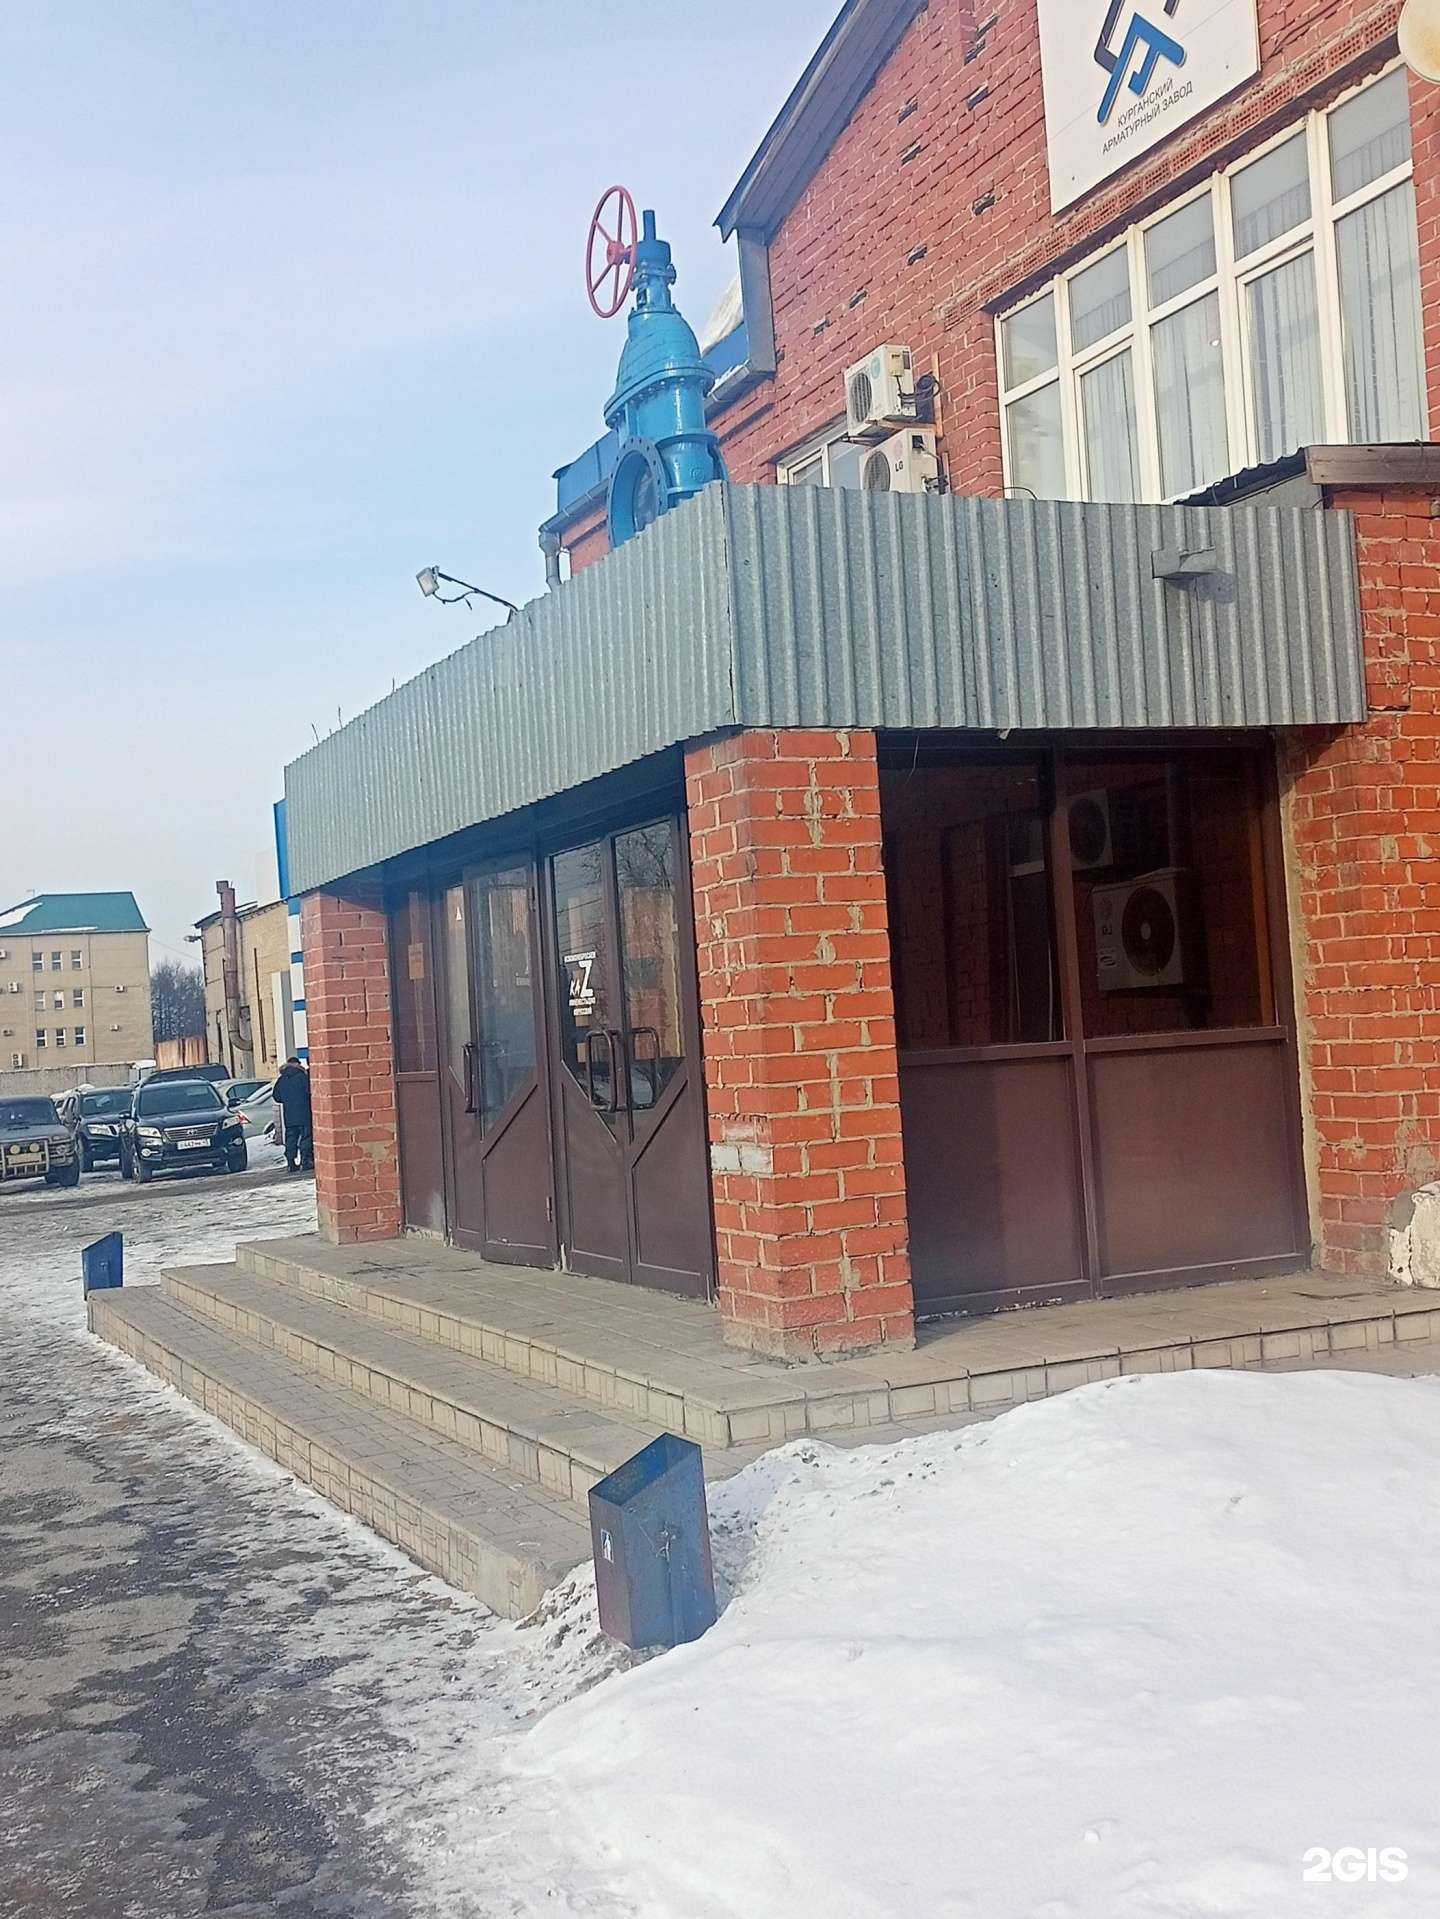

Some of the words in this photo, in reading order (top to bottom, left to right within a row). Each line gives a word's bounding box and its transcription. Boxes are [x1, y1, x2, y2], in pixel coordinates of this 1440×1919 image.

[1102, 104, 1161, 155] АРМАТУРНЫЙ
[1162, 80, 1193, 112] ЗАВОД
[1117, 76, 1173, 128] КУРГАНСКИЙ
[895, 460, 904, 472] LG
